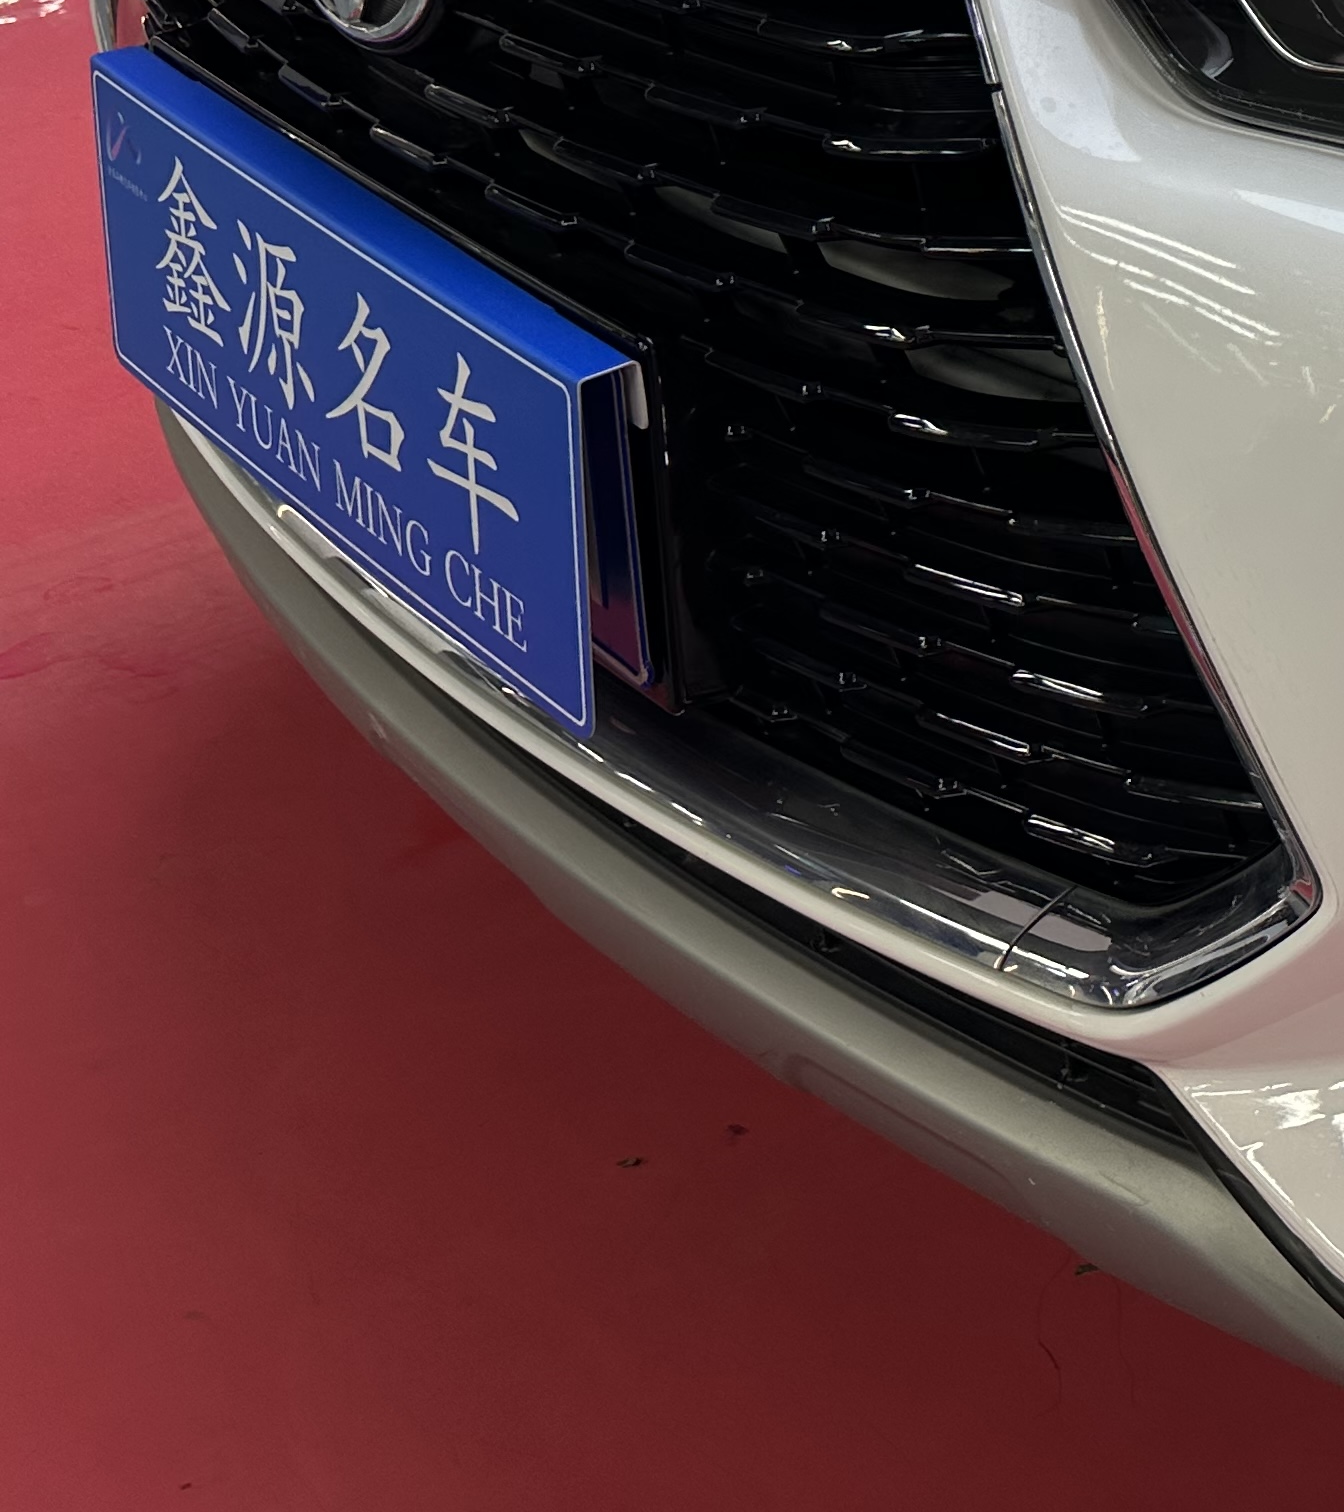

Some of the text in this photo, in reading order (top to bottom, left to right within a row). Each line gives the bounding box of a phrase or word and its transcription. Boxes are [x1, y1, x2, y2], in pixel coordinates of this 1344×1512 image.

[155, 155, 520, 555] 鑫源名车
[162, 326, 529, 653] XIN YUAN MING CHE
